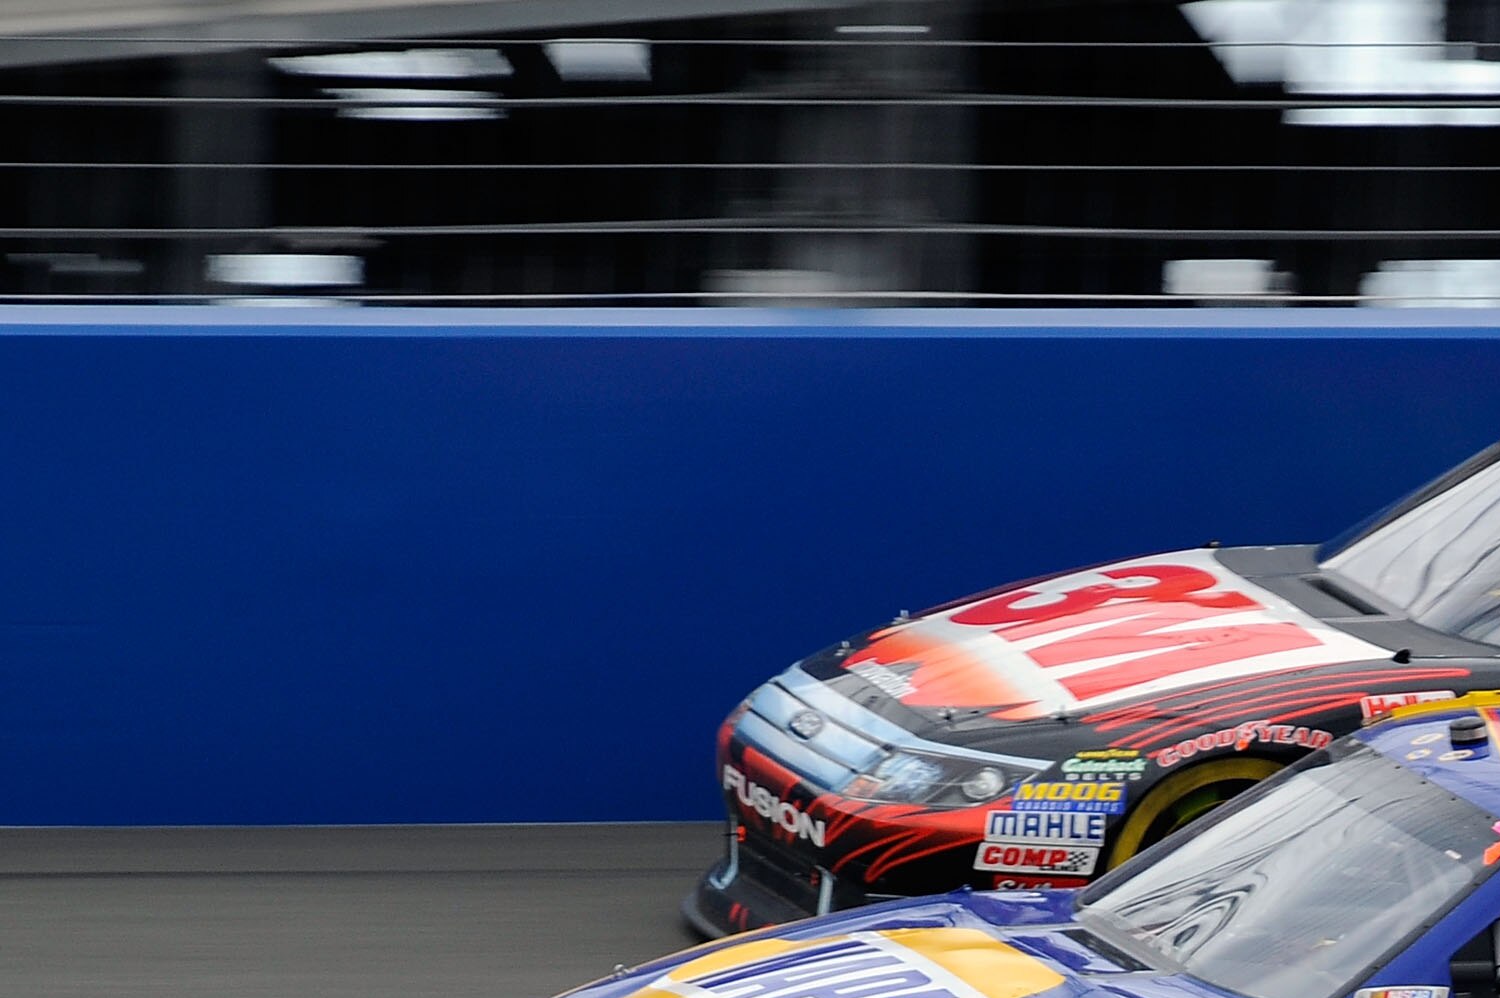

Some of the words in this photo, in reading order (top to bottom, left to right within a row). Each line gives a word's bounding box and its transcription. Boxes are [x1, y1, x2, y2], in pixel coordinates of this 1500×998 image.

[950, 564, 1325, 700] 3M
[1157, 722, 1333, 768] GOODYEAR
[723, 764, 826, 847] FUSION
[1016, 782, 1124, 801] MOOG
[990, 812, 1104, 840] MAHLE
[983, 846, 1068, 866] COMP
